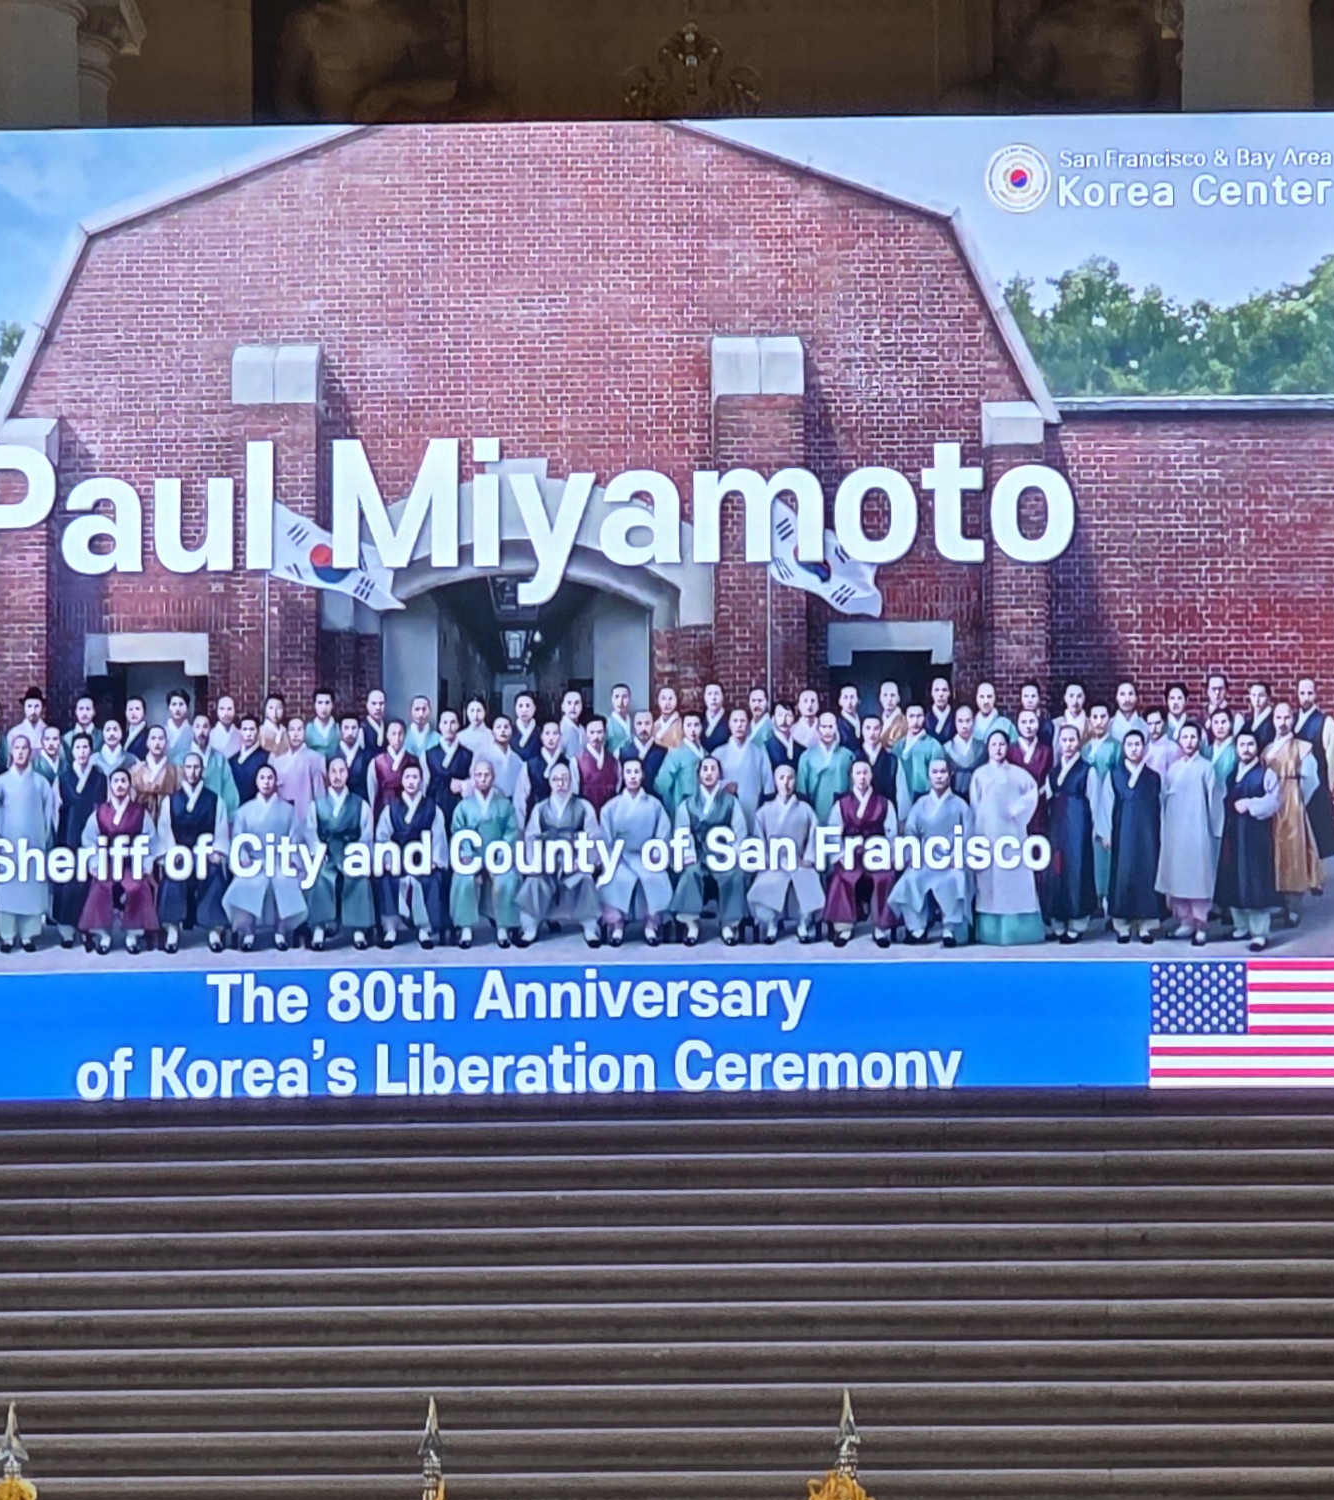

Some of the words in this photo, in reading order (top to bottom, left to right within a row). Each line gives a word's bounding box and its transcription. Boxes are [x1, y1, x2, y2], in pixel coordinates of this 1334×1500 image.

[1059, 150, 1099, 168] San
[1105, 148, 1206, 168] Francisco
[1213, 149, 1229, 167] &
[1237, 148, 1274, 170] Bay
[1283, 147, 1333, 167] Area
[1057, 175, 1175, 207] Korea
[1192, 173, 1333, 206] Center
[332, 437, 1076, 607] Miyamoto
[164, 833, 215, 881] of
[229, 833, 327, 889] City
[343, 831, 431, 877] and
[450, 829, 624, 889] County
[641, 827, 690, 872] of
[705, 827, 796, 872] San
[815, 824, 1051, 872] Francisco
[206, 972, 308, 1024] The
[327, 969, 455, 1022] 80th
[473, 968, 811, 1031] Anniversary
[77, 1047, 133, 1100] of
[150, 1039, 357, 1099] Korea's
[376, 1041, 656, 1097] Liberation
[674, 1039, 962, 1092] Ceremony
